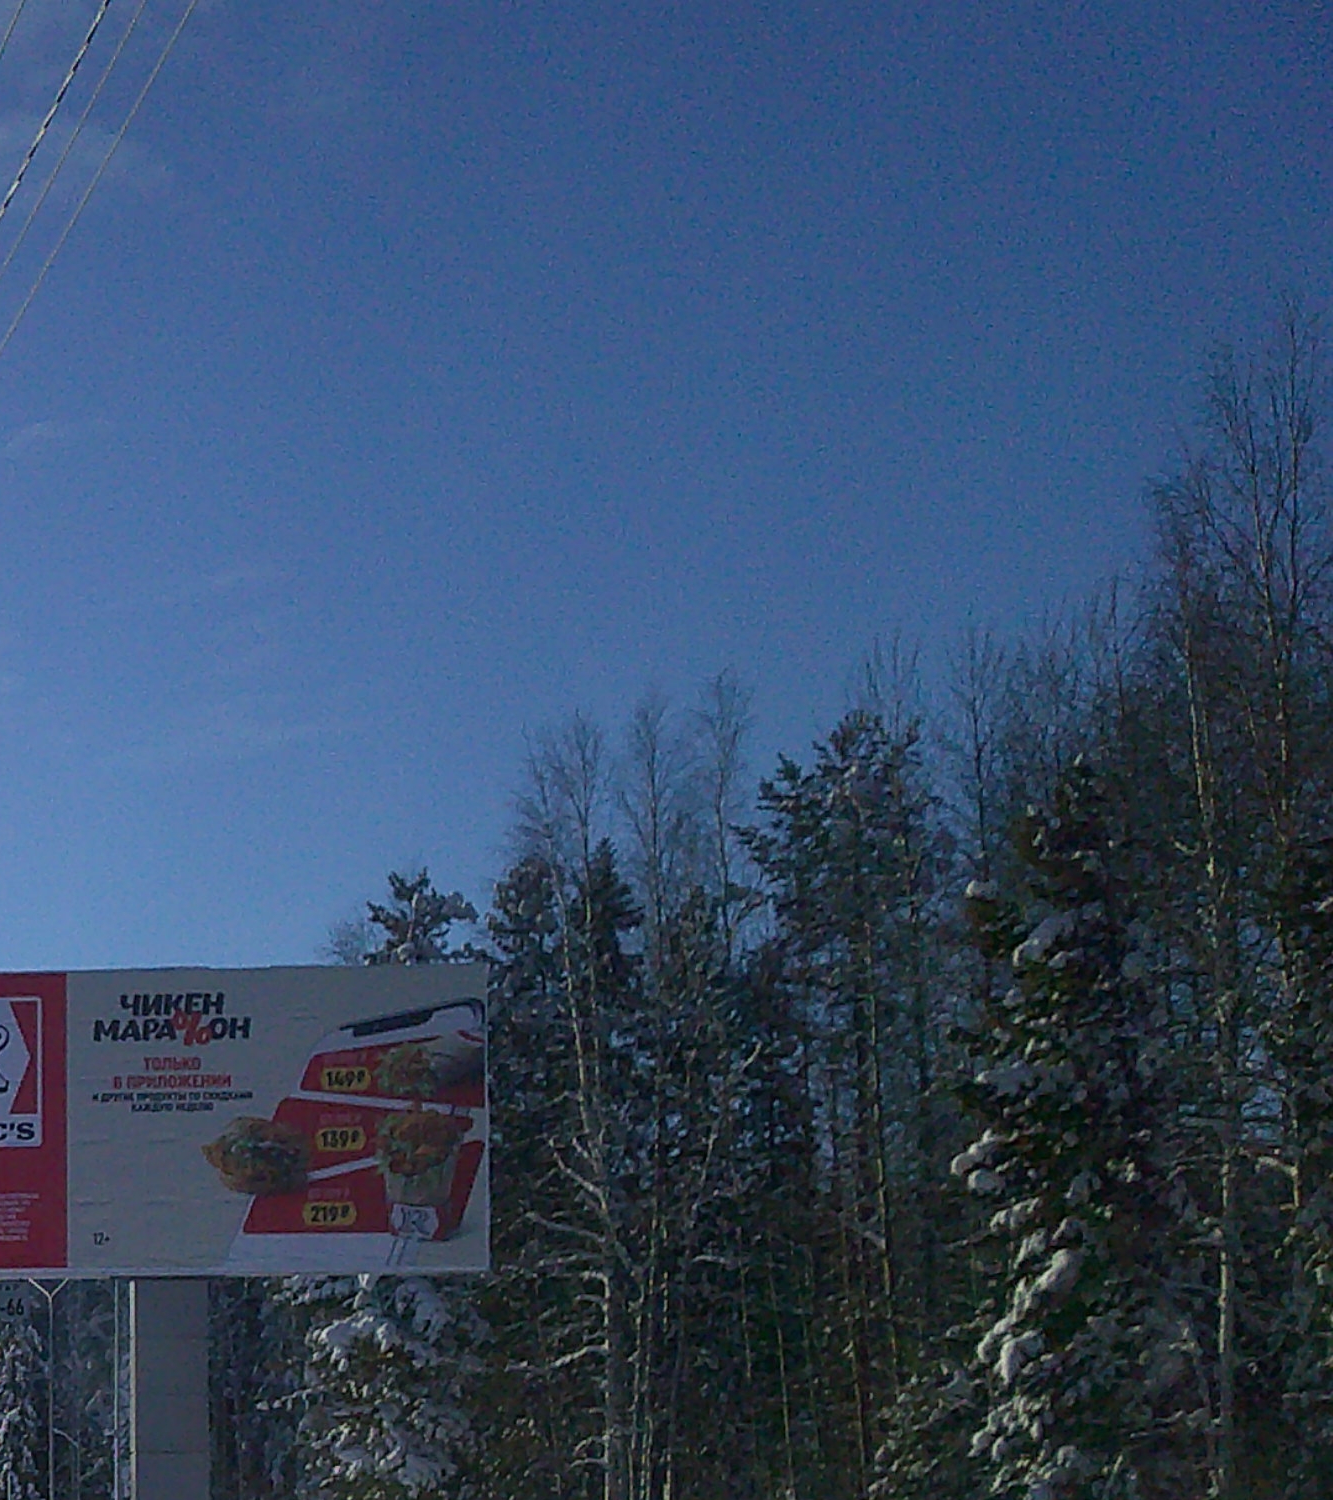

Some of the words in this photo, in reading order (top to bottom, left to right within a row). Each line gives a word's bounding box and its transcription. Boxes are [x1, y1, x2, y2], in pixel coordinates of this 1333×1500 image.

[119, 992, 225, 1017] ЧИКЕН
[143, 1056, 202, 1072] ТОЛЬКО
[113, 1075, 123, 1090] В
[127, 1073, 232, 1090] ПРИЛОЖЕНИИ
[93, 1231, 110, 1246] 12+
